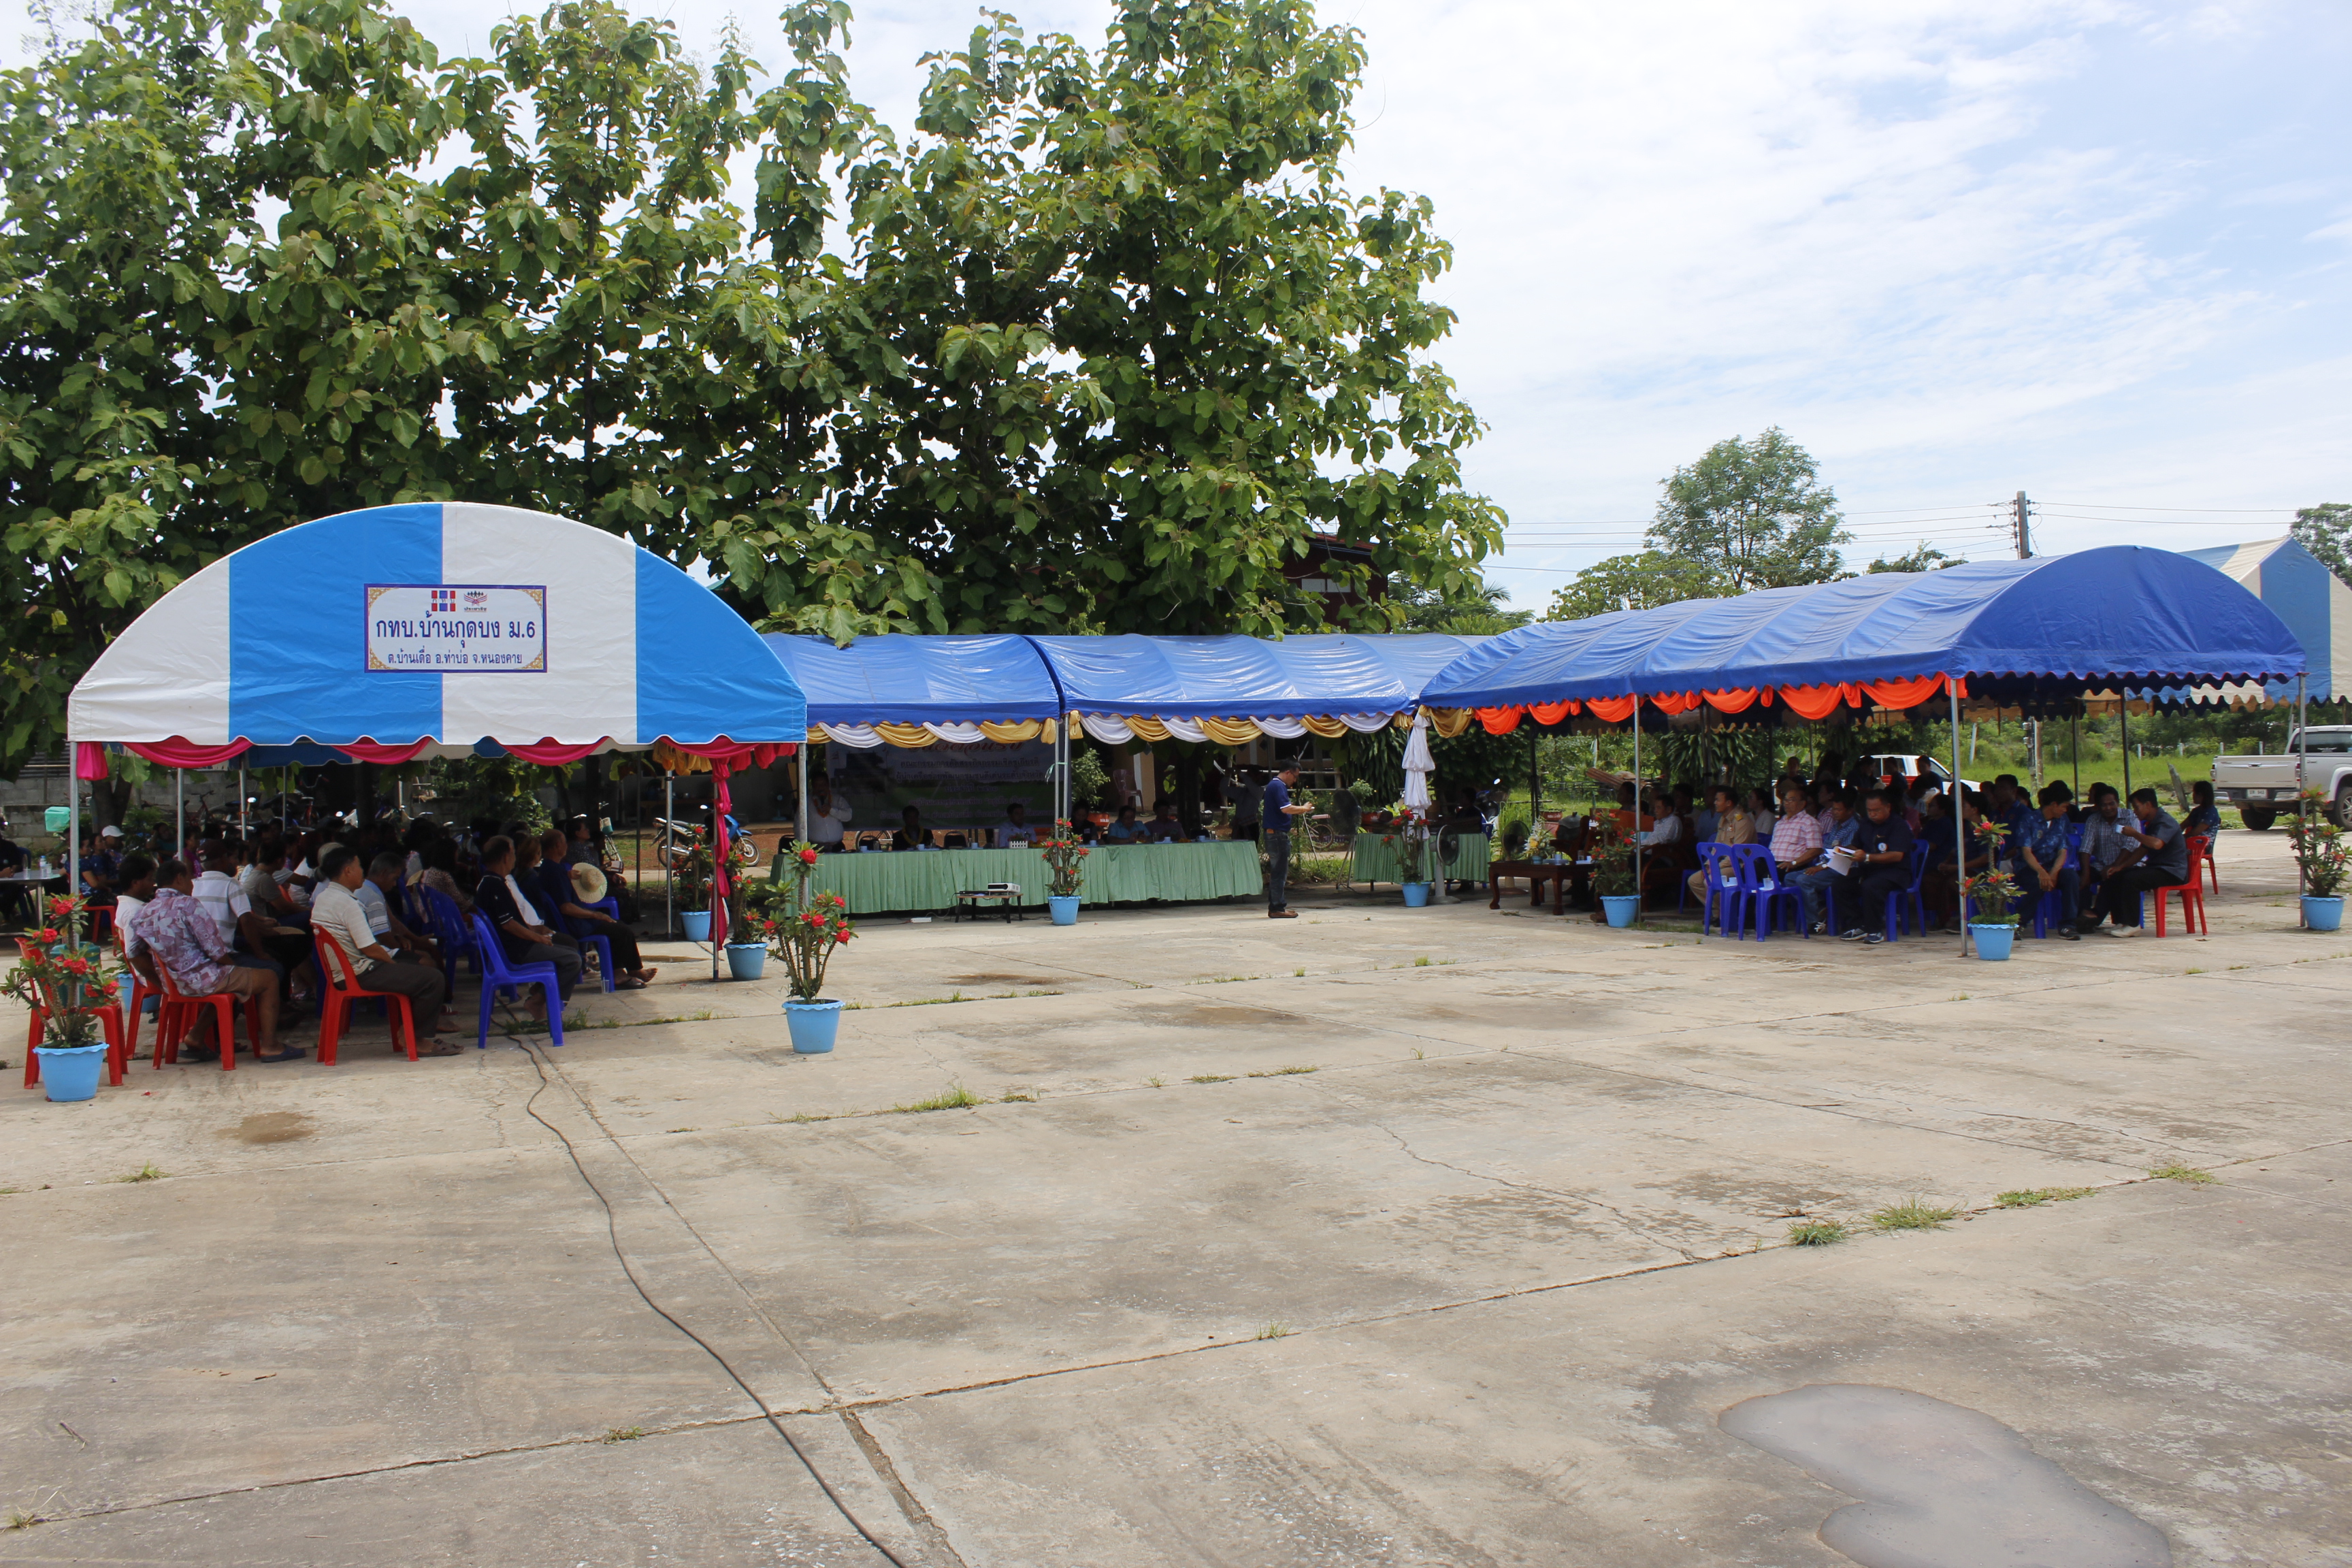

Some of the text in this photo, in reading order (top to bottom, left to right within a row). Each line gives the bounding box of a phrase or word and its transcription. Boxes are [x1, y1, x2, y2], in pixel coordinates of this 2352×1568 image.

[376, 610, 536, 648] กทบ.บ้านกุดบง ม.6
[436, 650, 469, 664] อ.ท่าบ่อ
[472, 651, 523, 664] จ.หนองคาย
